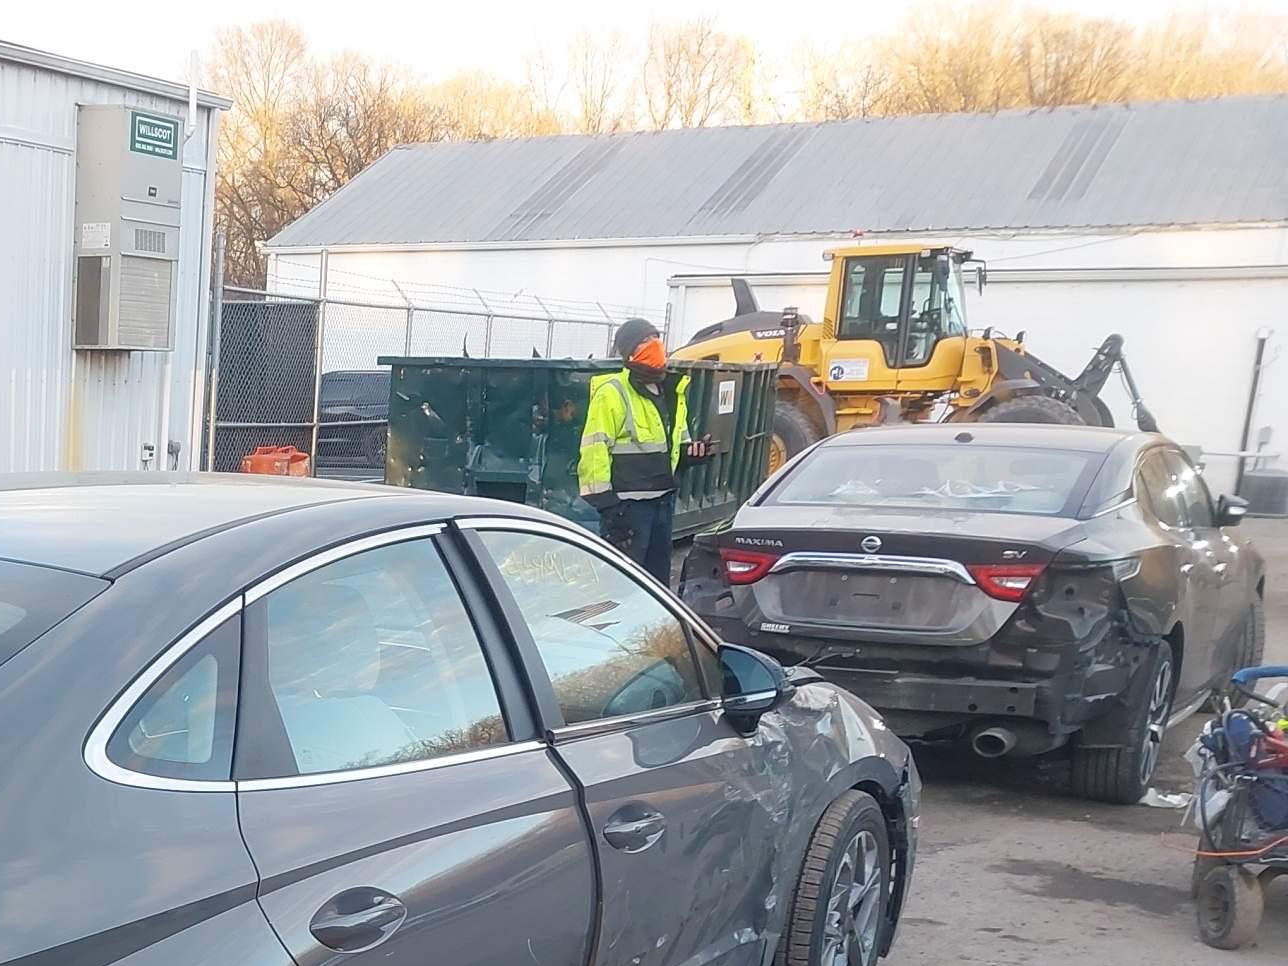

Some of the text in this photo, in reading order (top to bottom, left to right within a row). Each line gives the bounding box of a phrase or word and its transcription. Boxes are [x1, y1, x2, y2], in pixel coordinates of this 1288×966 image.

[139, 124, 171, 140] WILLSCOT
[735, 537, 784, 547] MAXIMA
[1002, 550, 1028, 559] SV
